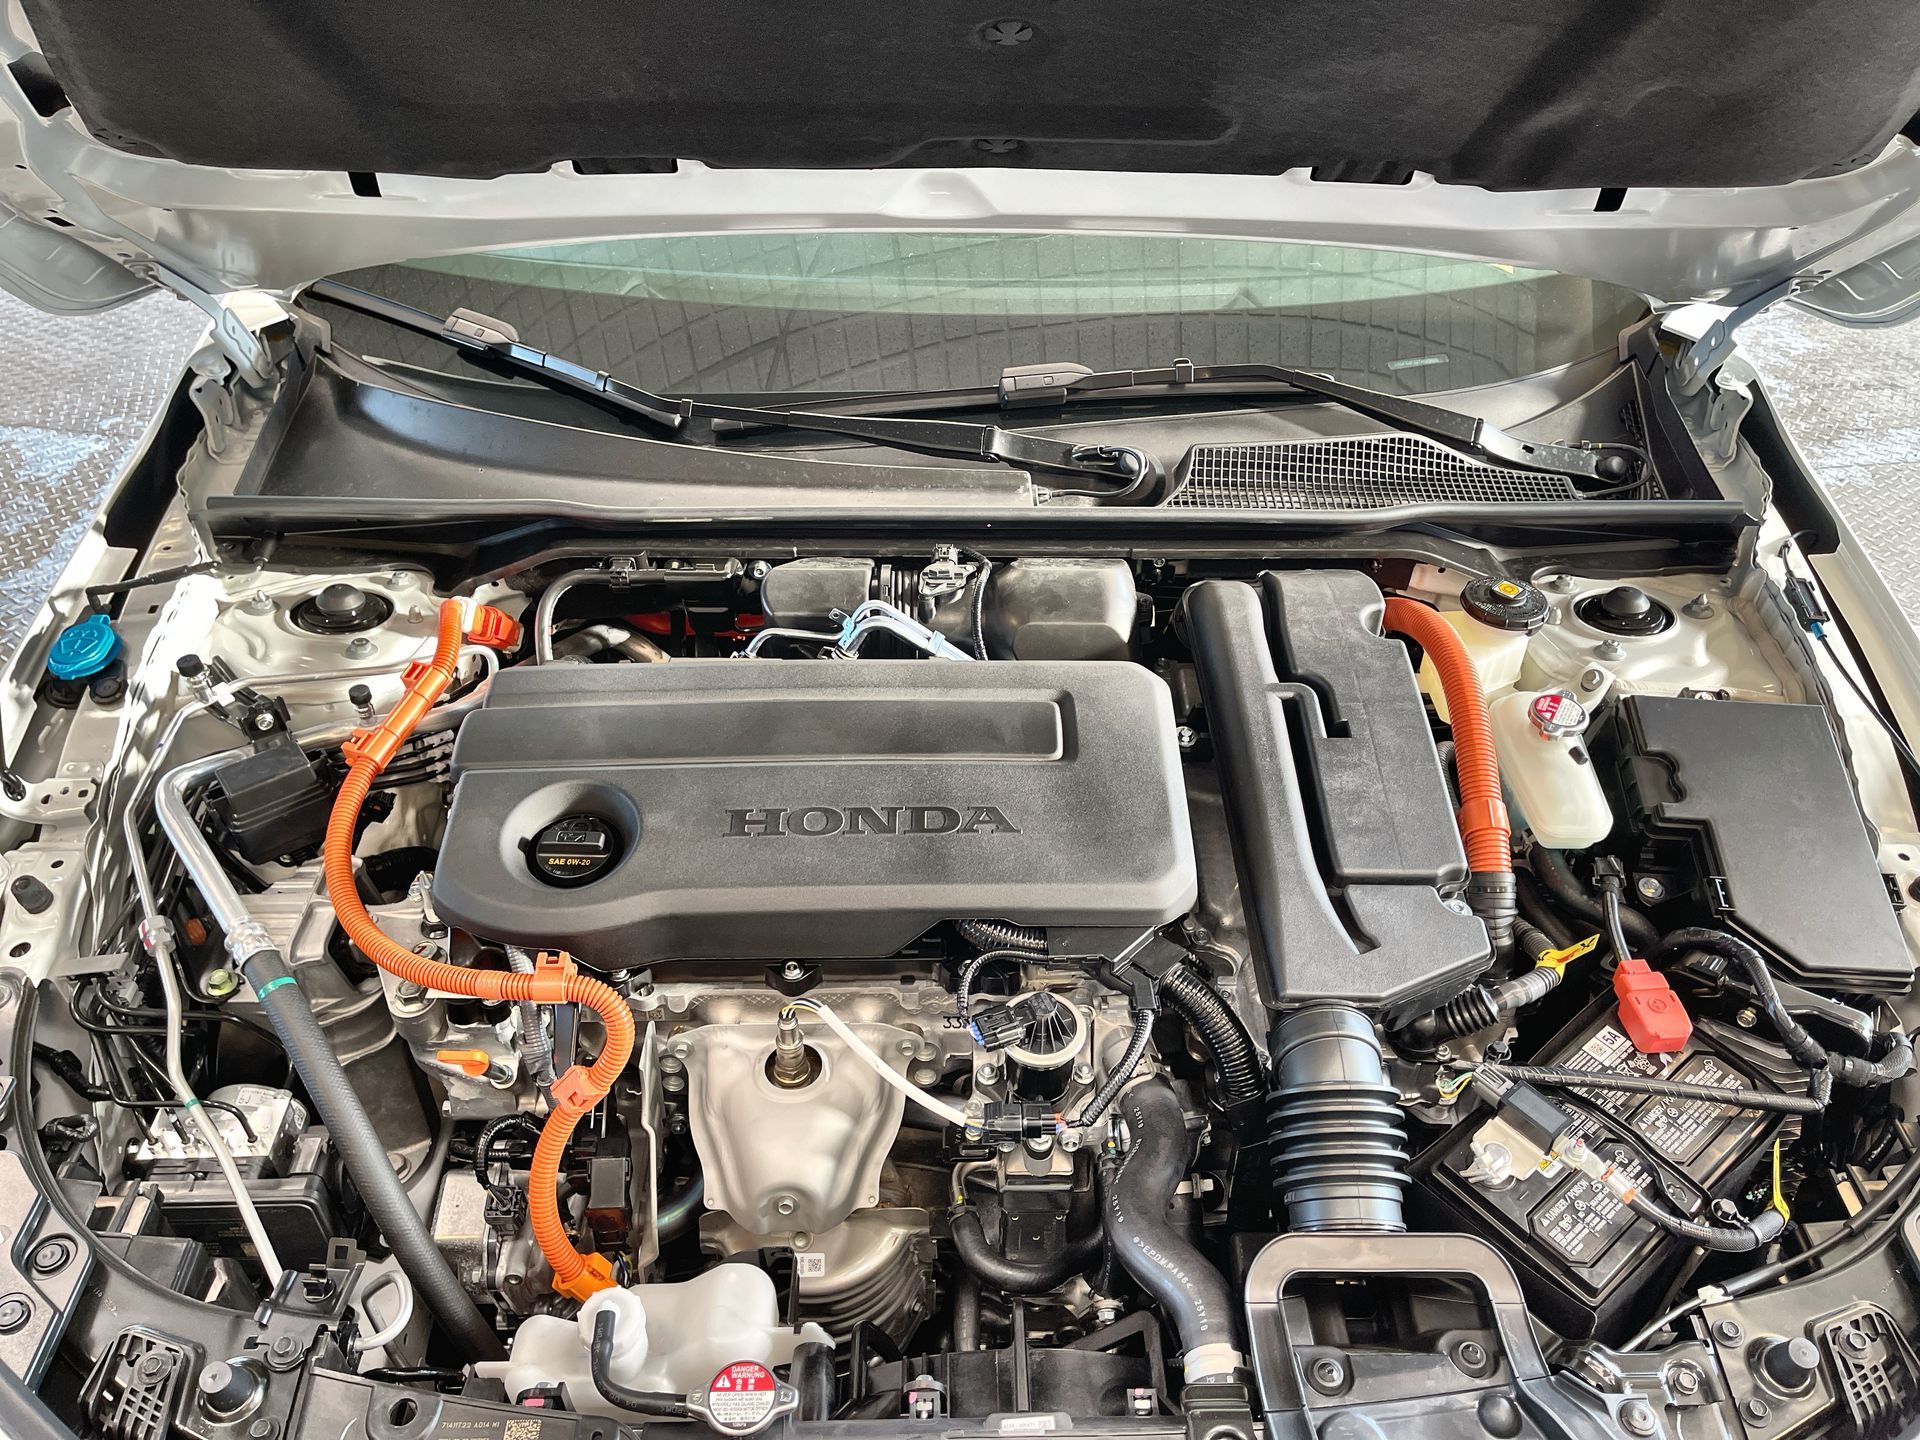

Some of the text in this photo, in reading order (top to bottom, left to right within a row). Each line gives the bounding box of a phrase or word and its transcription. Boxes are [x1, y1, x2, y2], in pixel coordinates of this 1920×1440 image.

[722, 805, 1024, 838] HONDA
[548, 858, 591, 866] SAE 0W-20
[1602, 1030, 1621, 1045] 5A
[731, 1365, 759, 1373] DANGER
